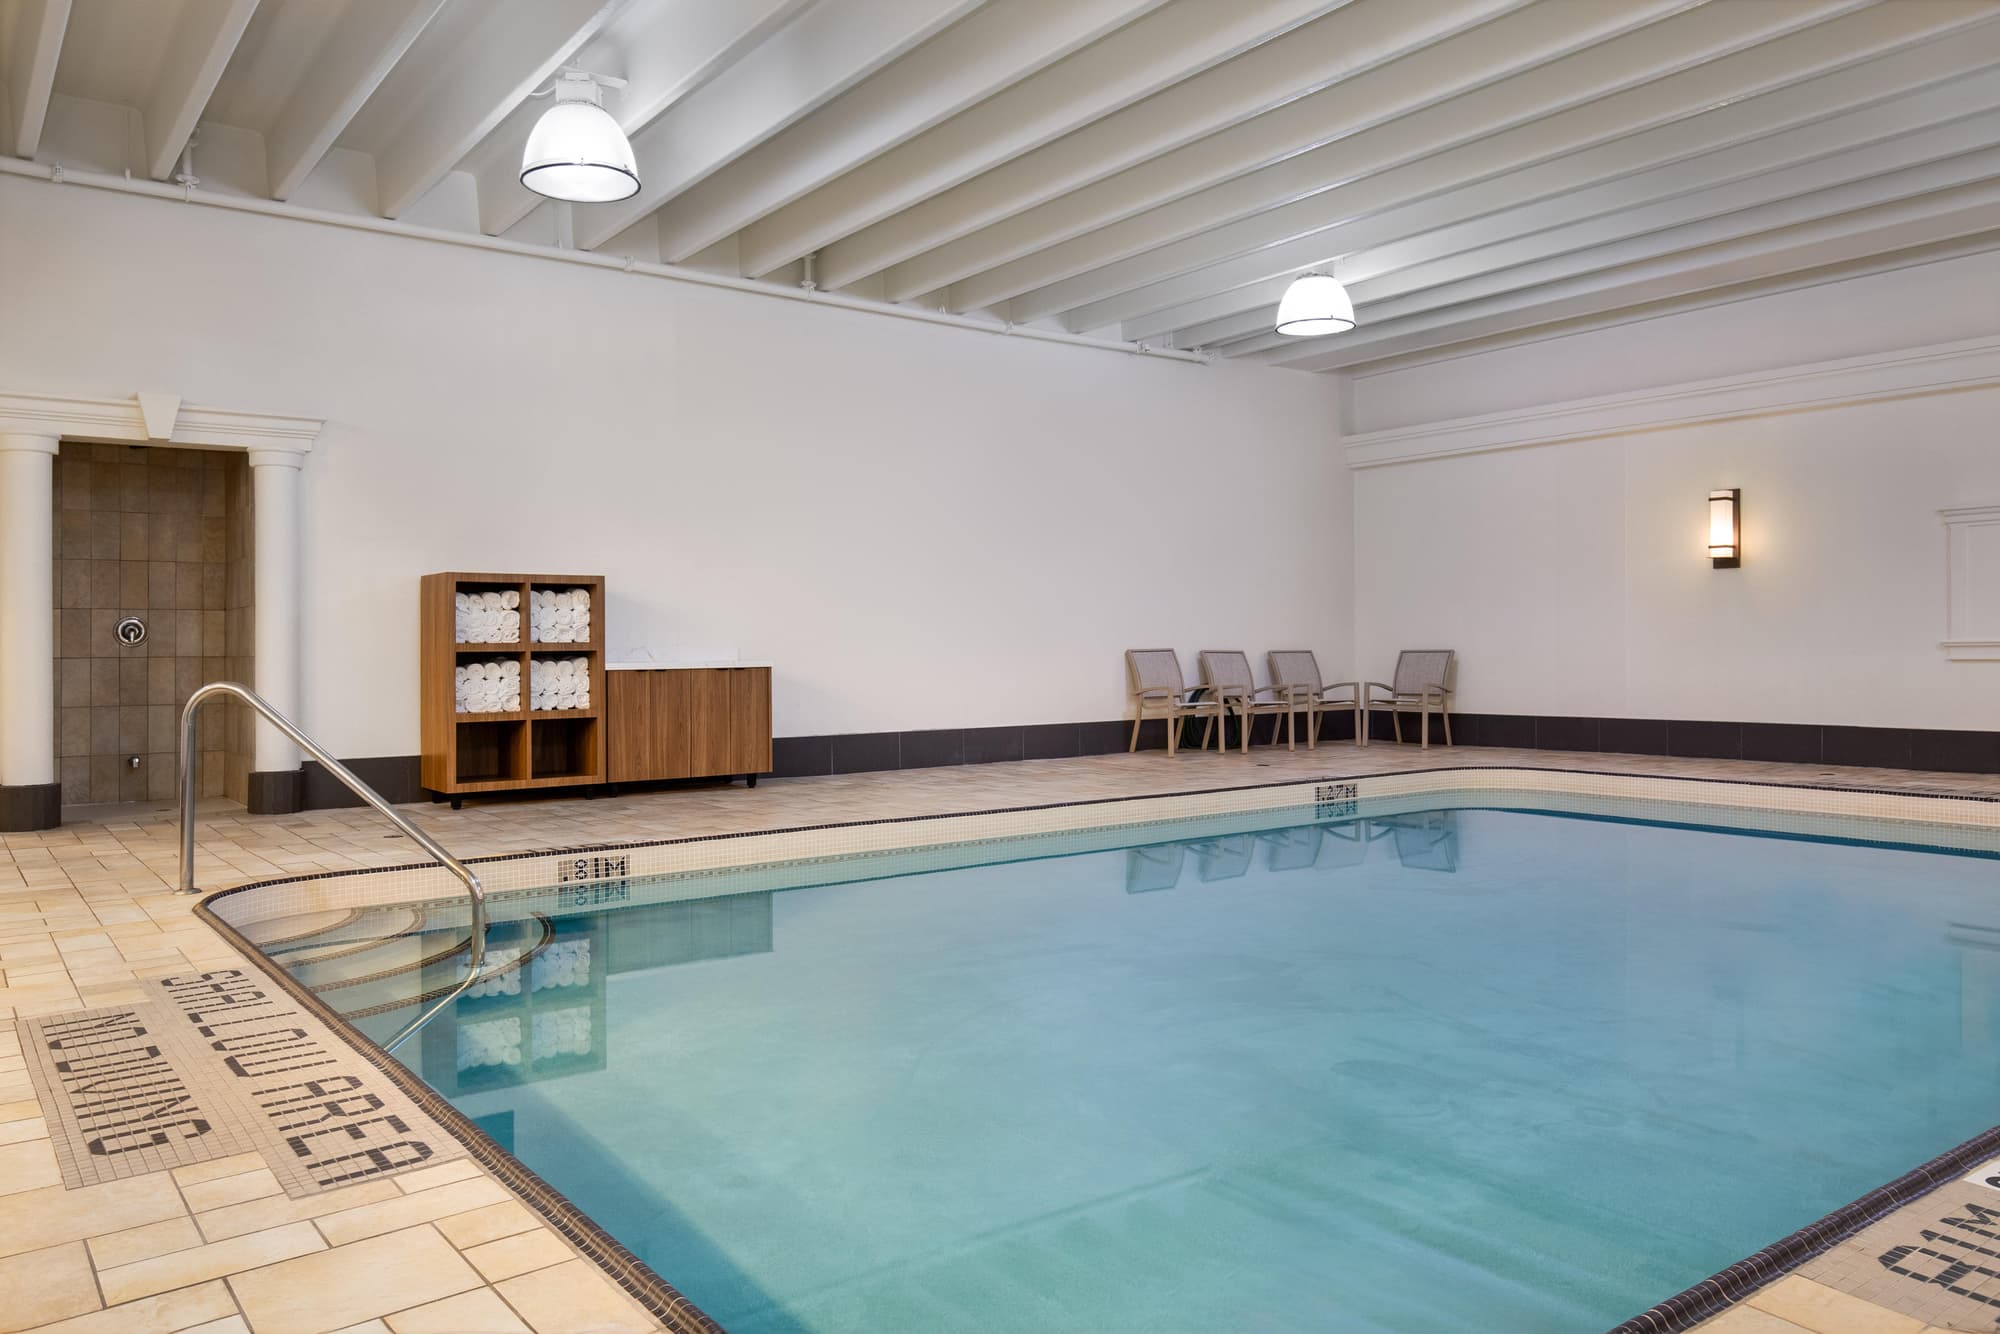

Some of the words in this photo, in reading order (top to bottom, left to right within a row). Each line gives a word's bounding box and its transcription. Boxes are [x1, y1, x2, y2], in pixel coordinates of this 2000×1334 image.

[41, 1011, 147, 1050] NO
[161, 970, 337, 1077] SHALLOW
[252, 1075, 434, 1187] AREA
[55, 1045, 212, 1156] DIVING
